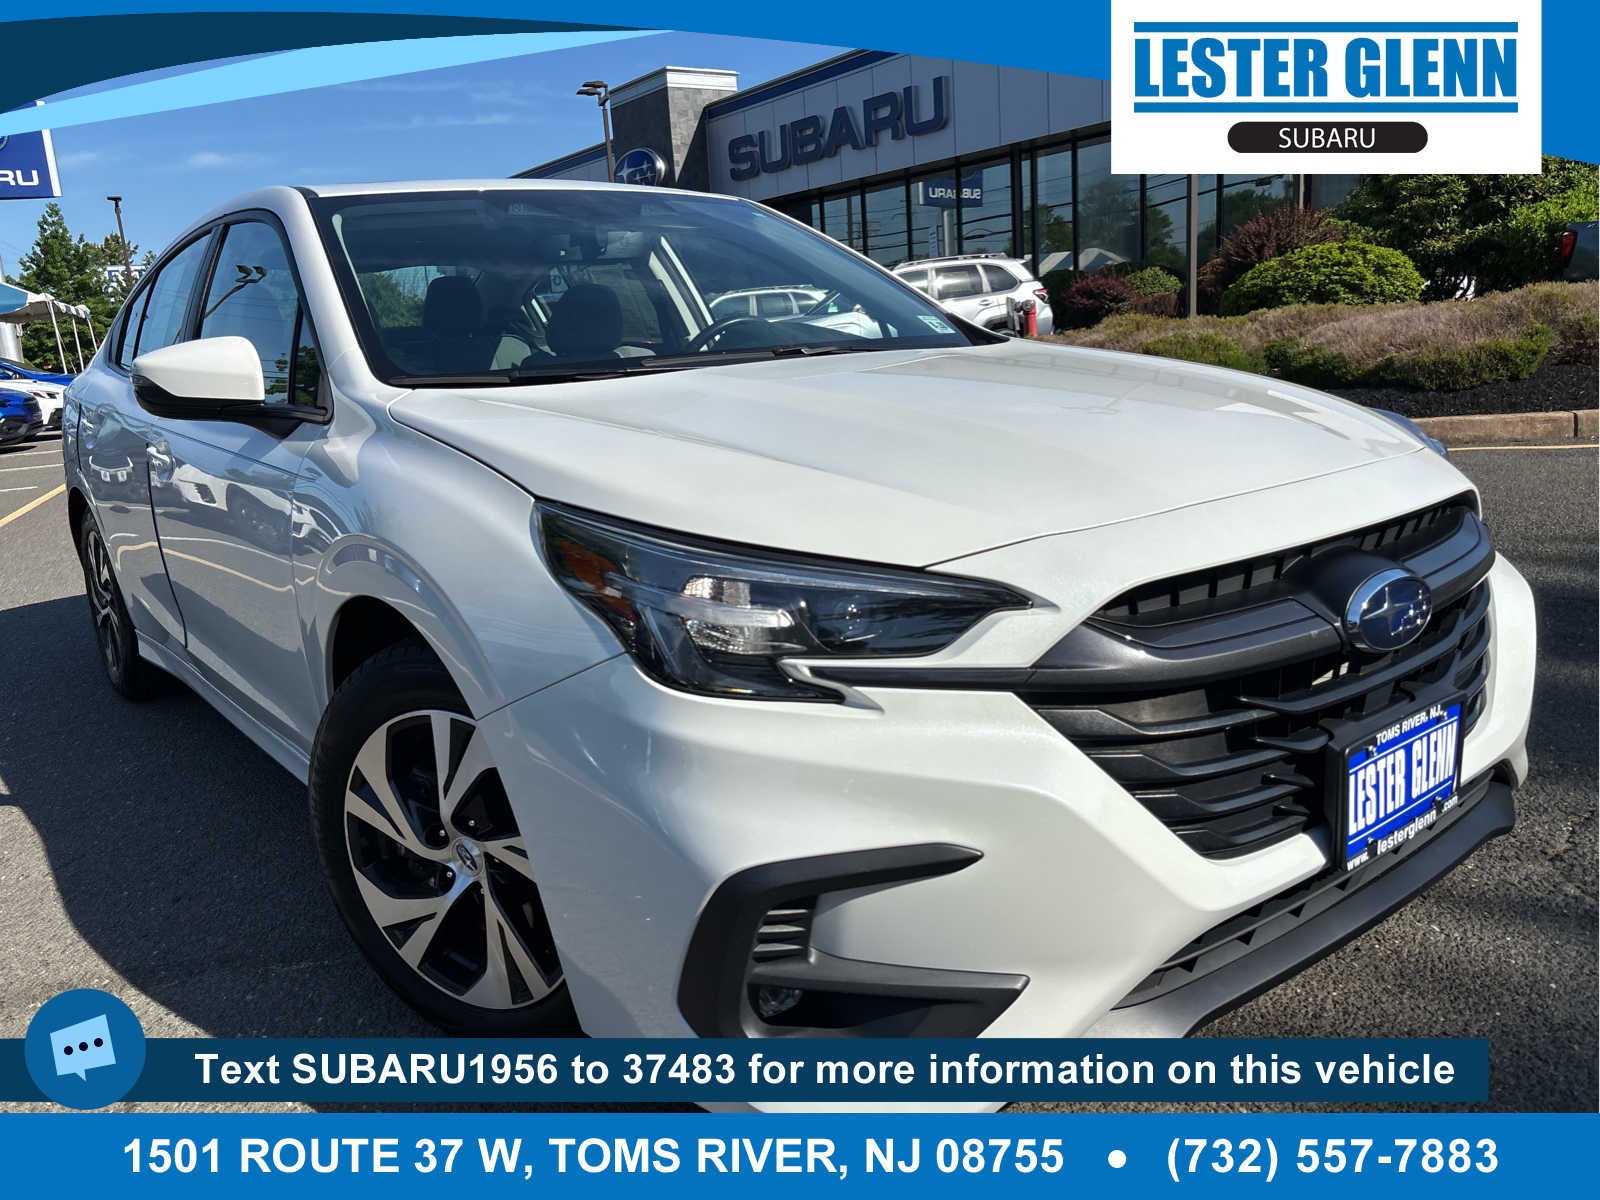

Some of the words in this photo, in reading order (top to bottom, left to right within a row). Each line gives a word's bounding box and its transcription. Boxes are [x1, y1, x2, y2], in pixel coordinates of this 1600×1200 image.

[728, 76, 948, 181] SUBARU
[1348, 749, 1406, 836] LESTER
[1411, 721, 1457, 799] GLENN
[1376, 724, 1400, 746] TOMS
